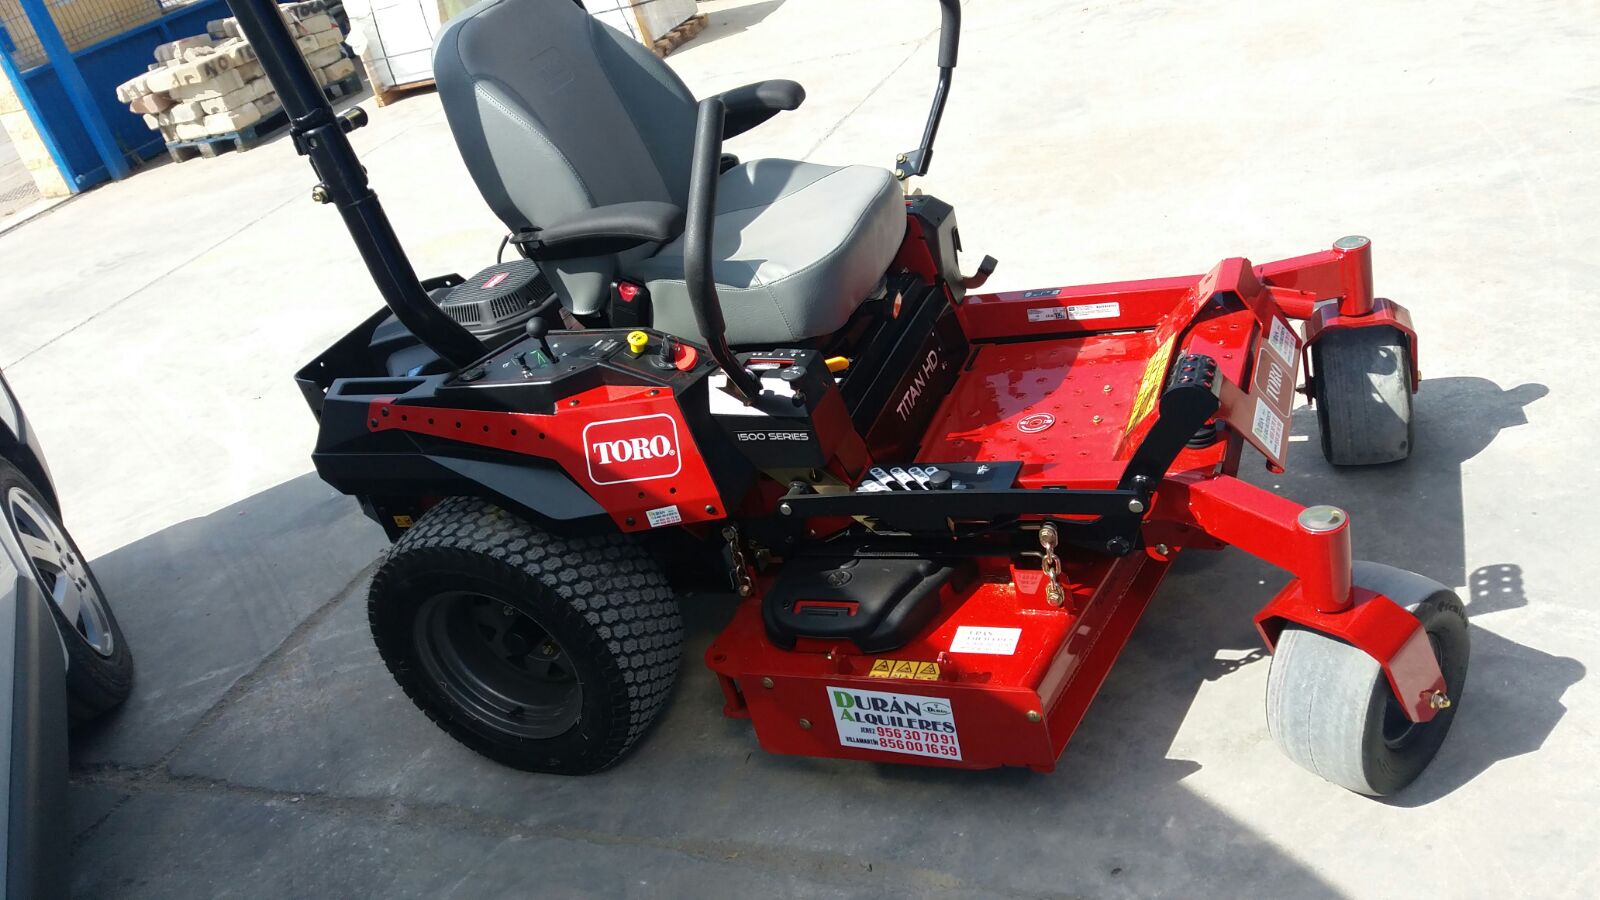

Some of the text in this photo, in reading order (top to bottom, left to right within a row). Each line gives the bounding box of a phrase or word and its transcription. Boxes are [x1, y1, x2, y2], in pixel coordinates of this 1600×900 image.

[896, 350, 938, 421] TITAN HD
[1266, 362, 1283, 403] TORO
[592, 434, 671, 465] TORO
[737, 432, 809, 441] 1500 SERIES
[840, 708, 956, 734] ALQUILERES
